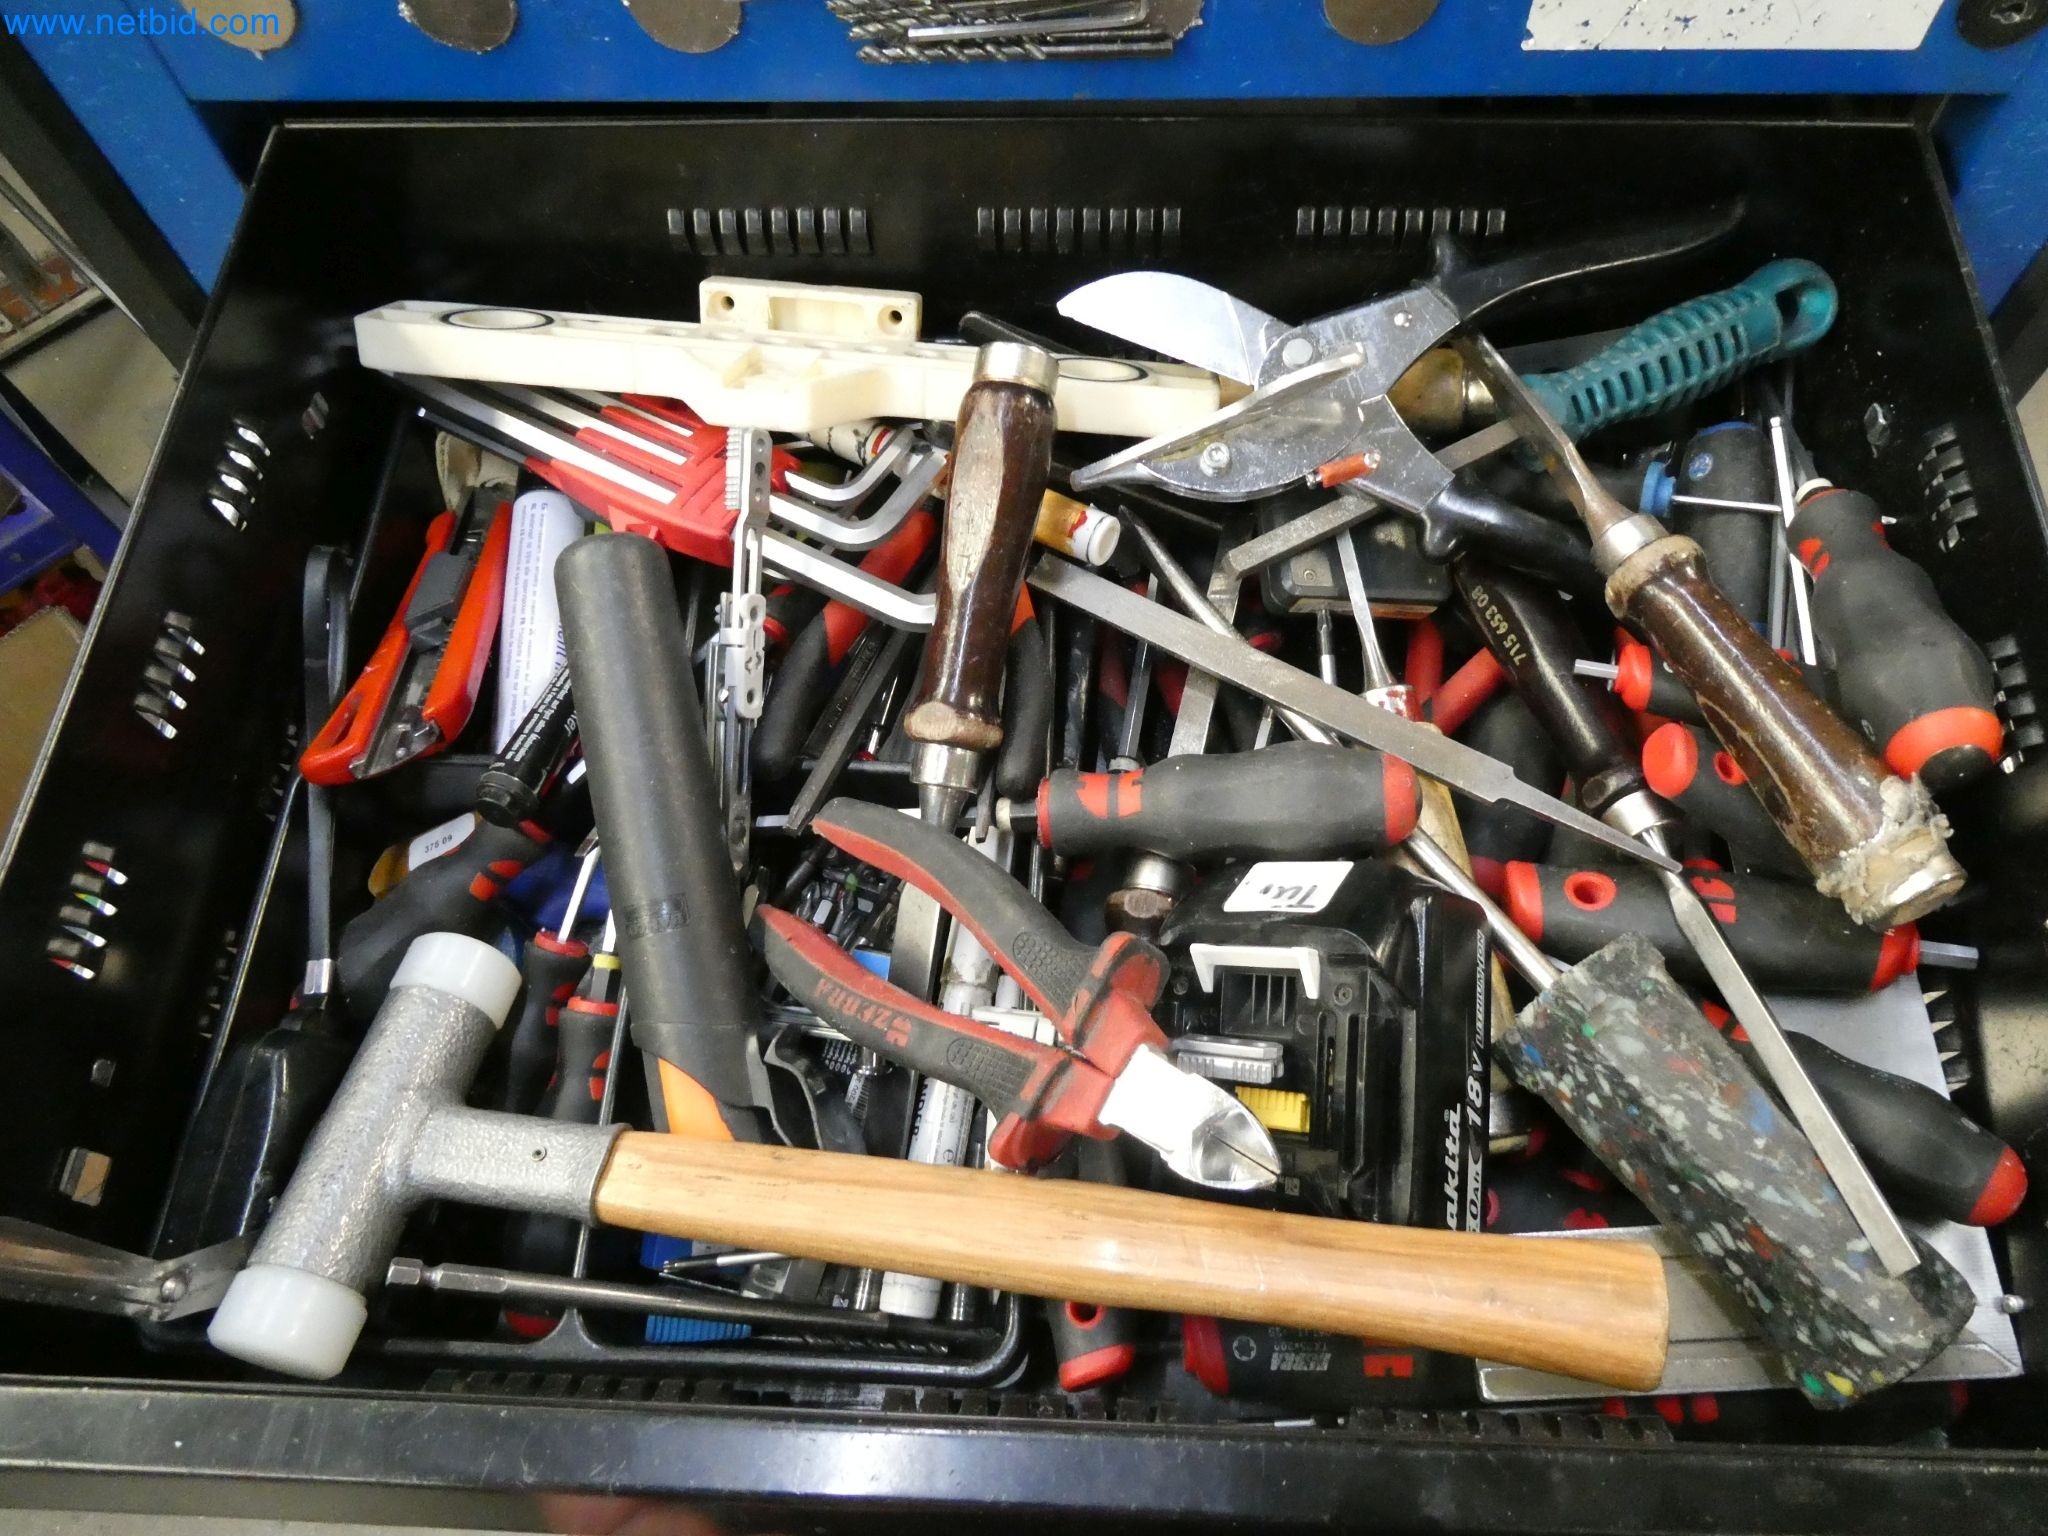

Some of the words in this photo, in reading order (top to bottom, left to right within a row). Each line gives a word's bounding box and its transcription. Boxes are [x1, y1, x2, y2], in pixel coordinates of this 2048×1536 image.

[1485, 605, 1509, 635] 653
[1503, 633, 1527, 666] 715
[1443, 1102, 1461, 1231] akita
